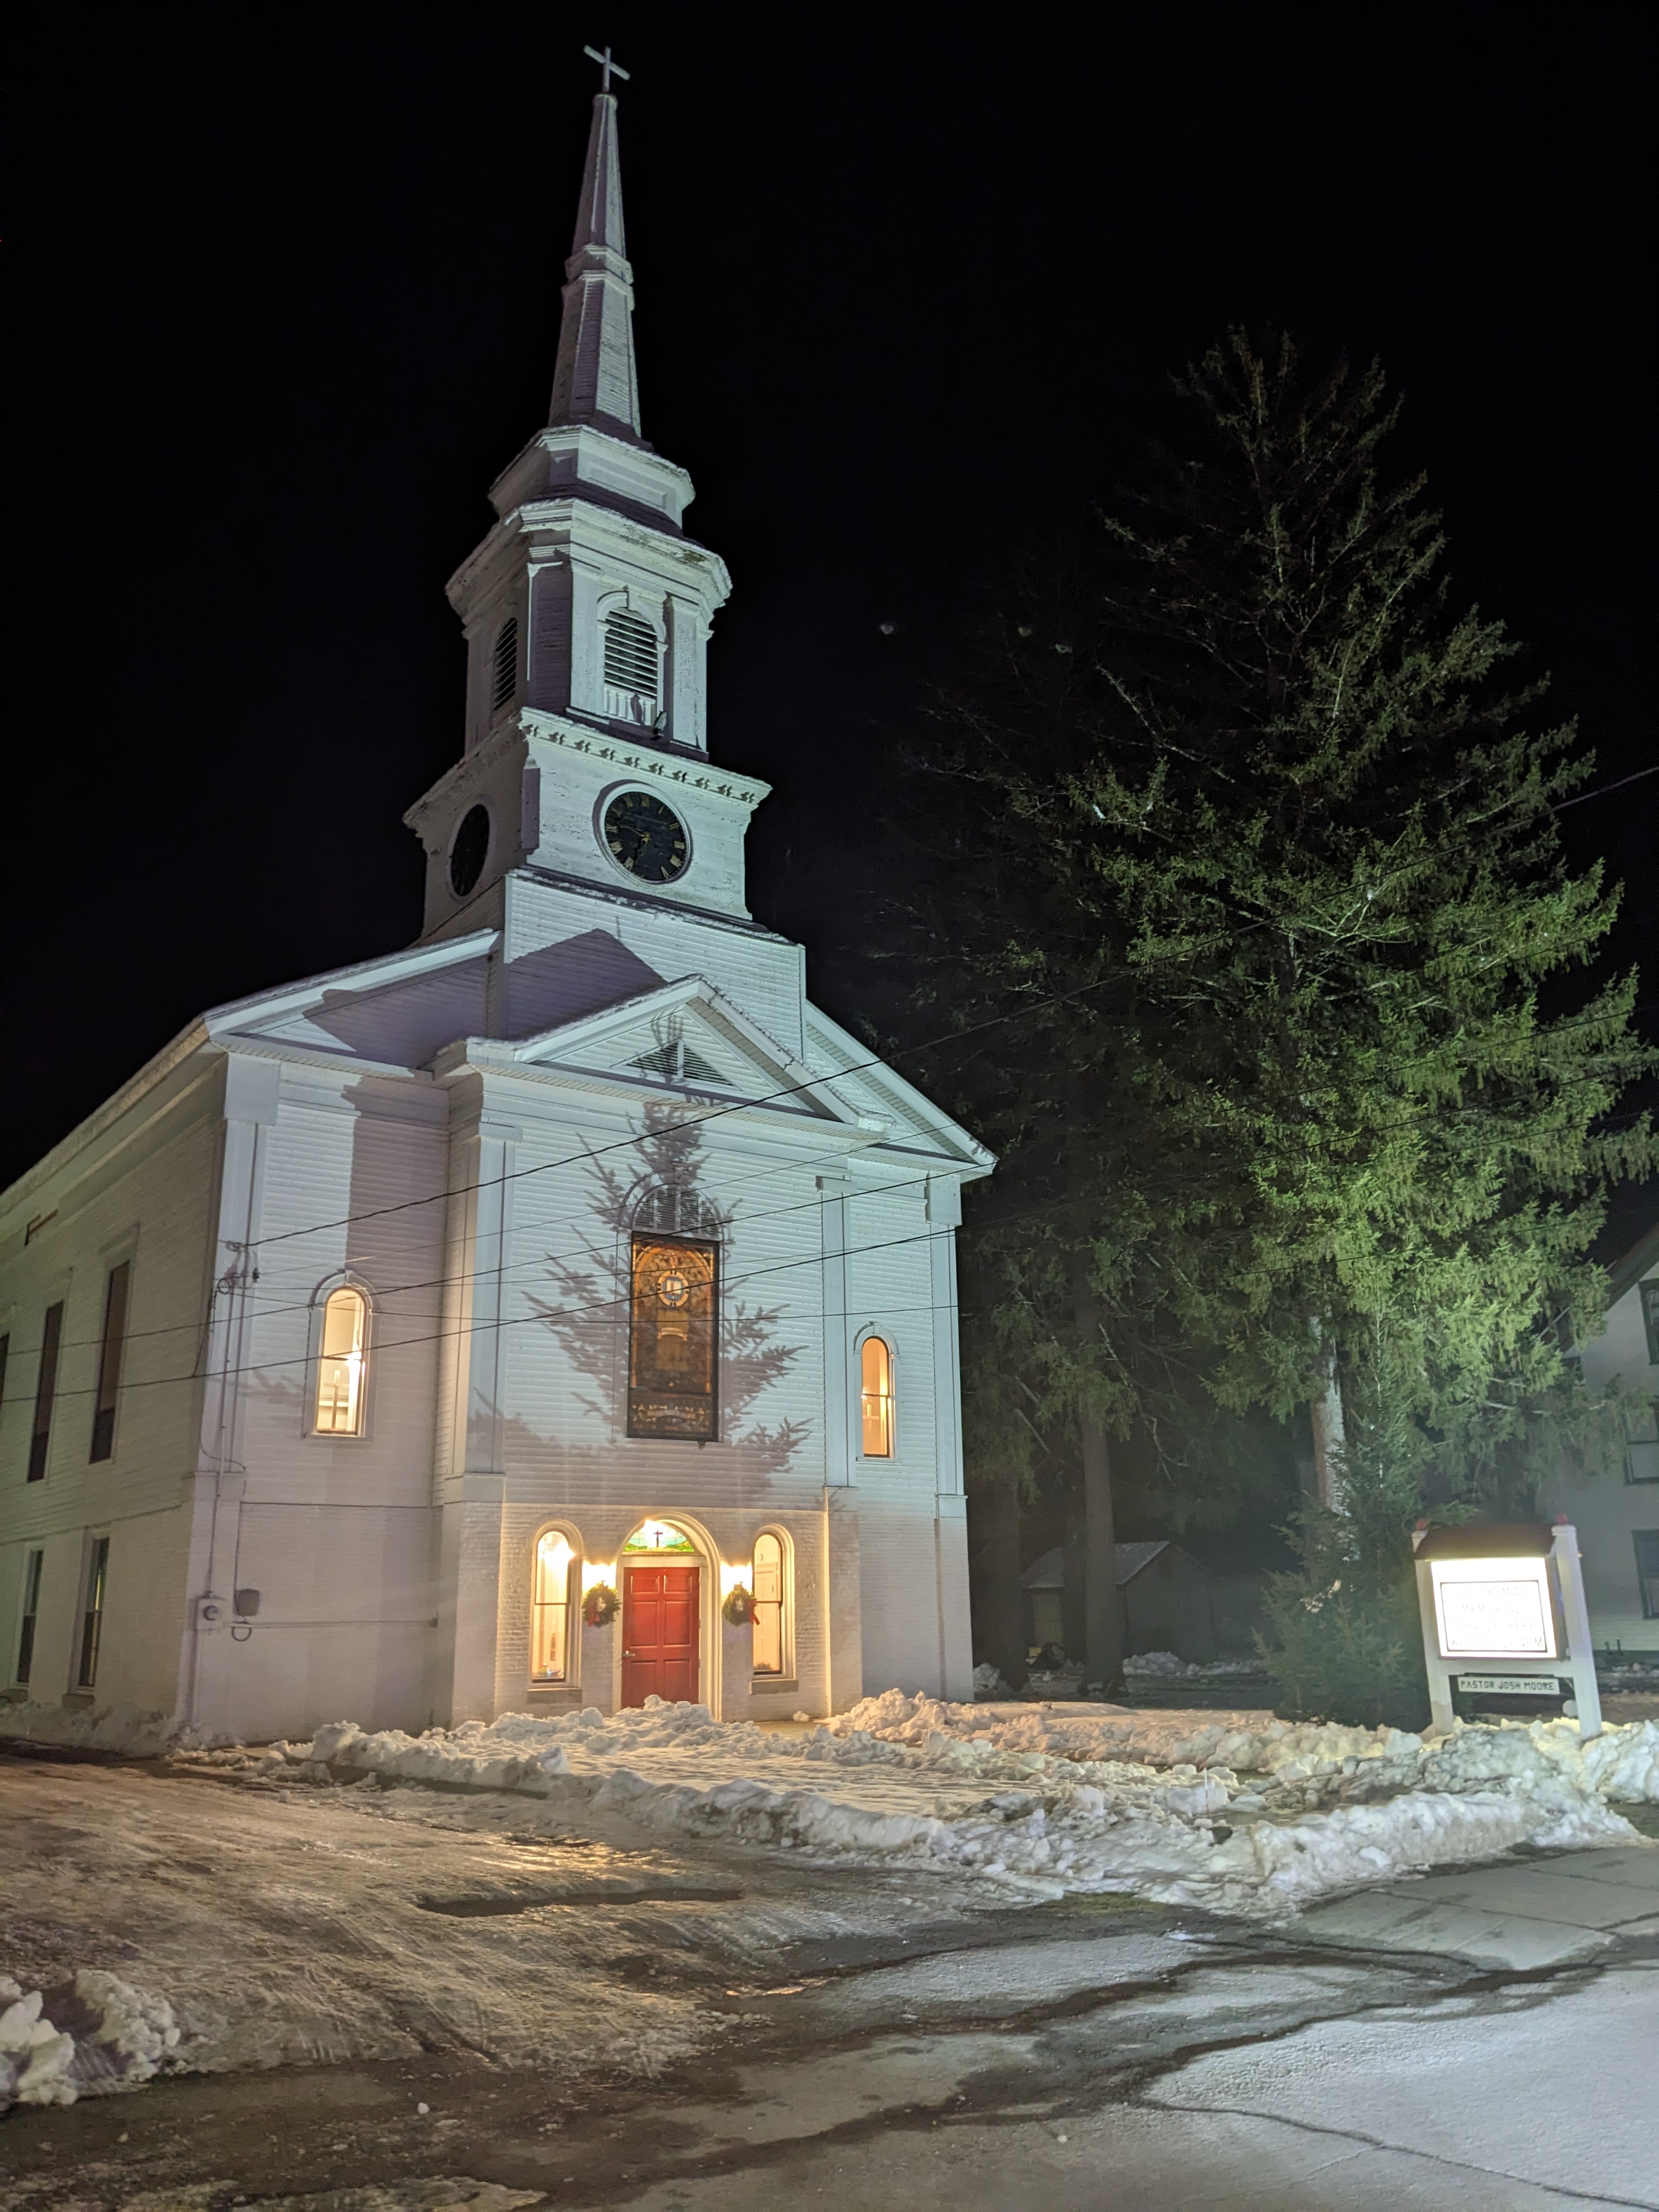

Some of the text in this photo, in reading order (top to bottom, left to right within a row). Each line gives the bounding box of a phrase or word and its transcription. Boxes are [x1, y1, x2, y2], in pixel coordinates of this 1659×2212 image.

[1454, 1586, 1527, 1598] SUE THOMAS
[1462, 1603, 1522, 1615] MEMORIAL
[1453, 1620, 1535, 1632] SERVICE HERE
[1452, 1637, 1472, 1647] WED
[1477, 1637, 1498, 1648] DEC
[1519, 1637, 1543, 1648] 4PM
[1460, 1680, 1554, 1691] PASTOR JOSH MOORE
